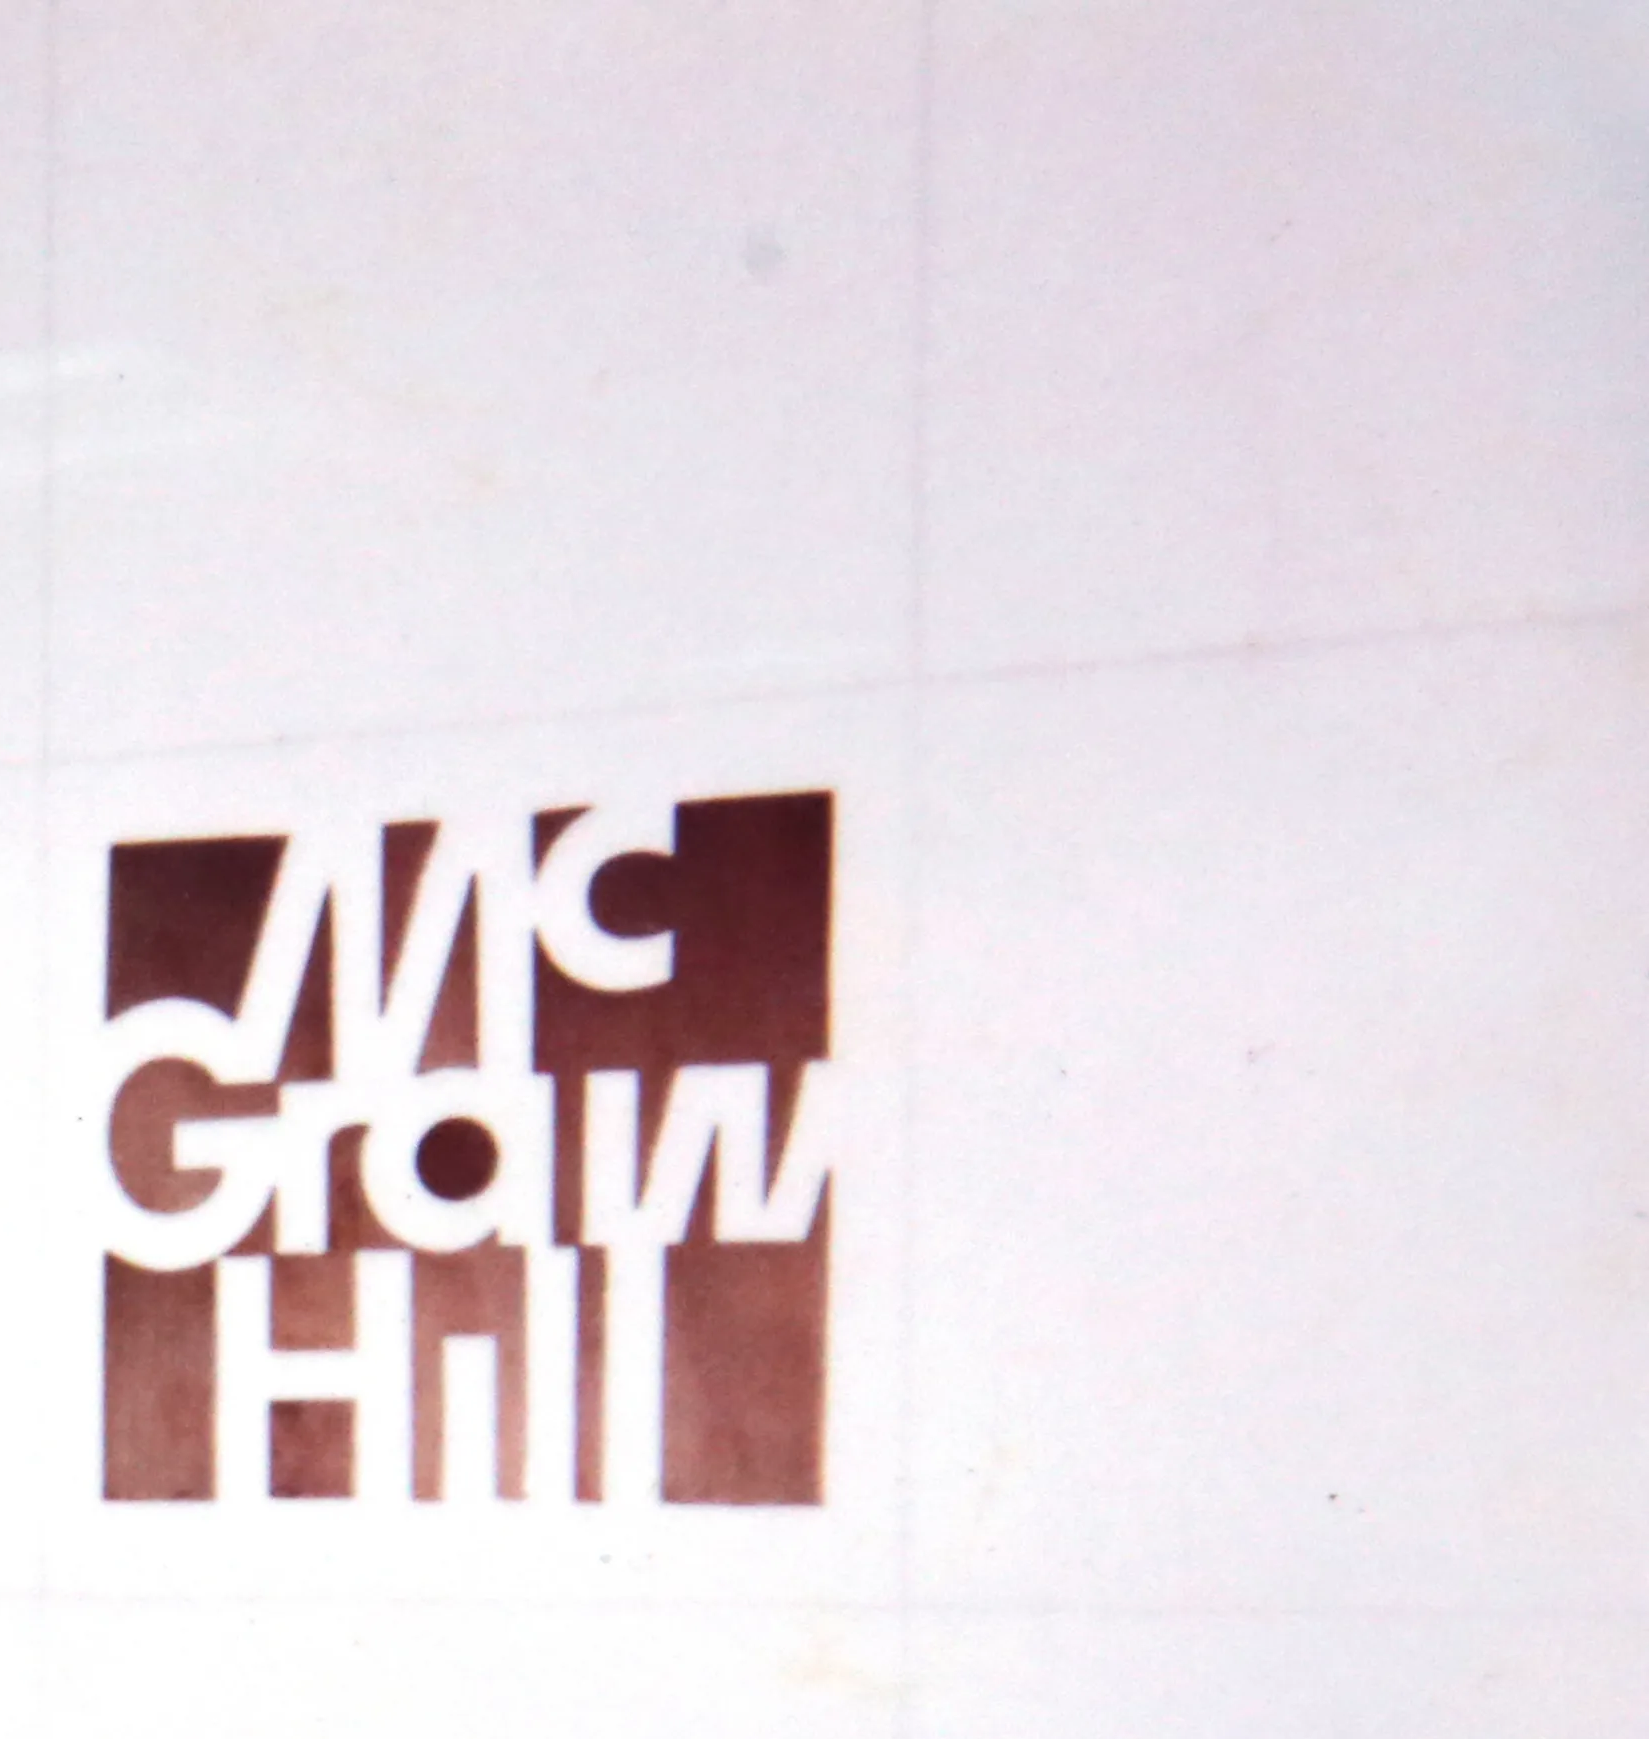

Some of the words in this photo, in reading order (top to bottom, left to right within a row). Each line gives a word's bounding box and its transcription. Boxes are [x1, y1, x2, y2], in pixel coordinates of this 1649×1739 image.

[219, 802, 675, 1084] Mc
[103, 997, 833, 1272] Graw
[215, 1246, 665, 1503] Hill
